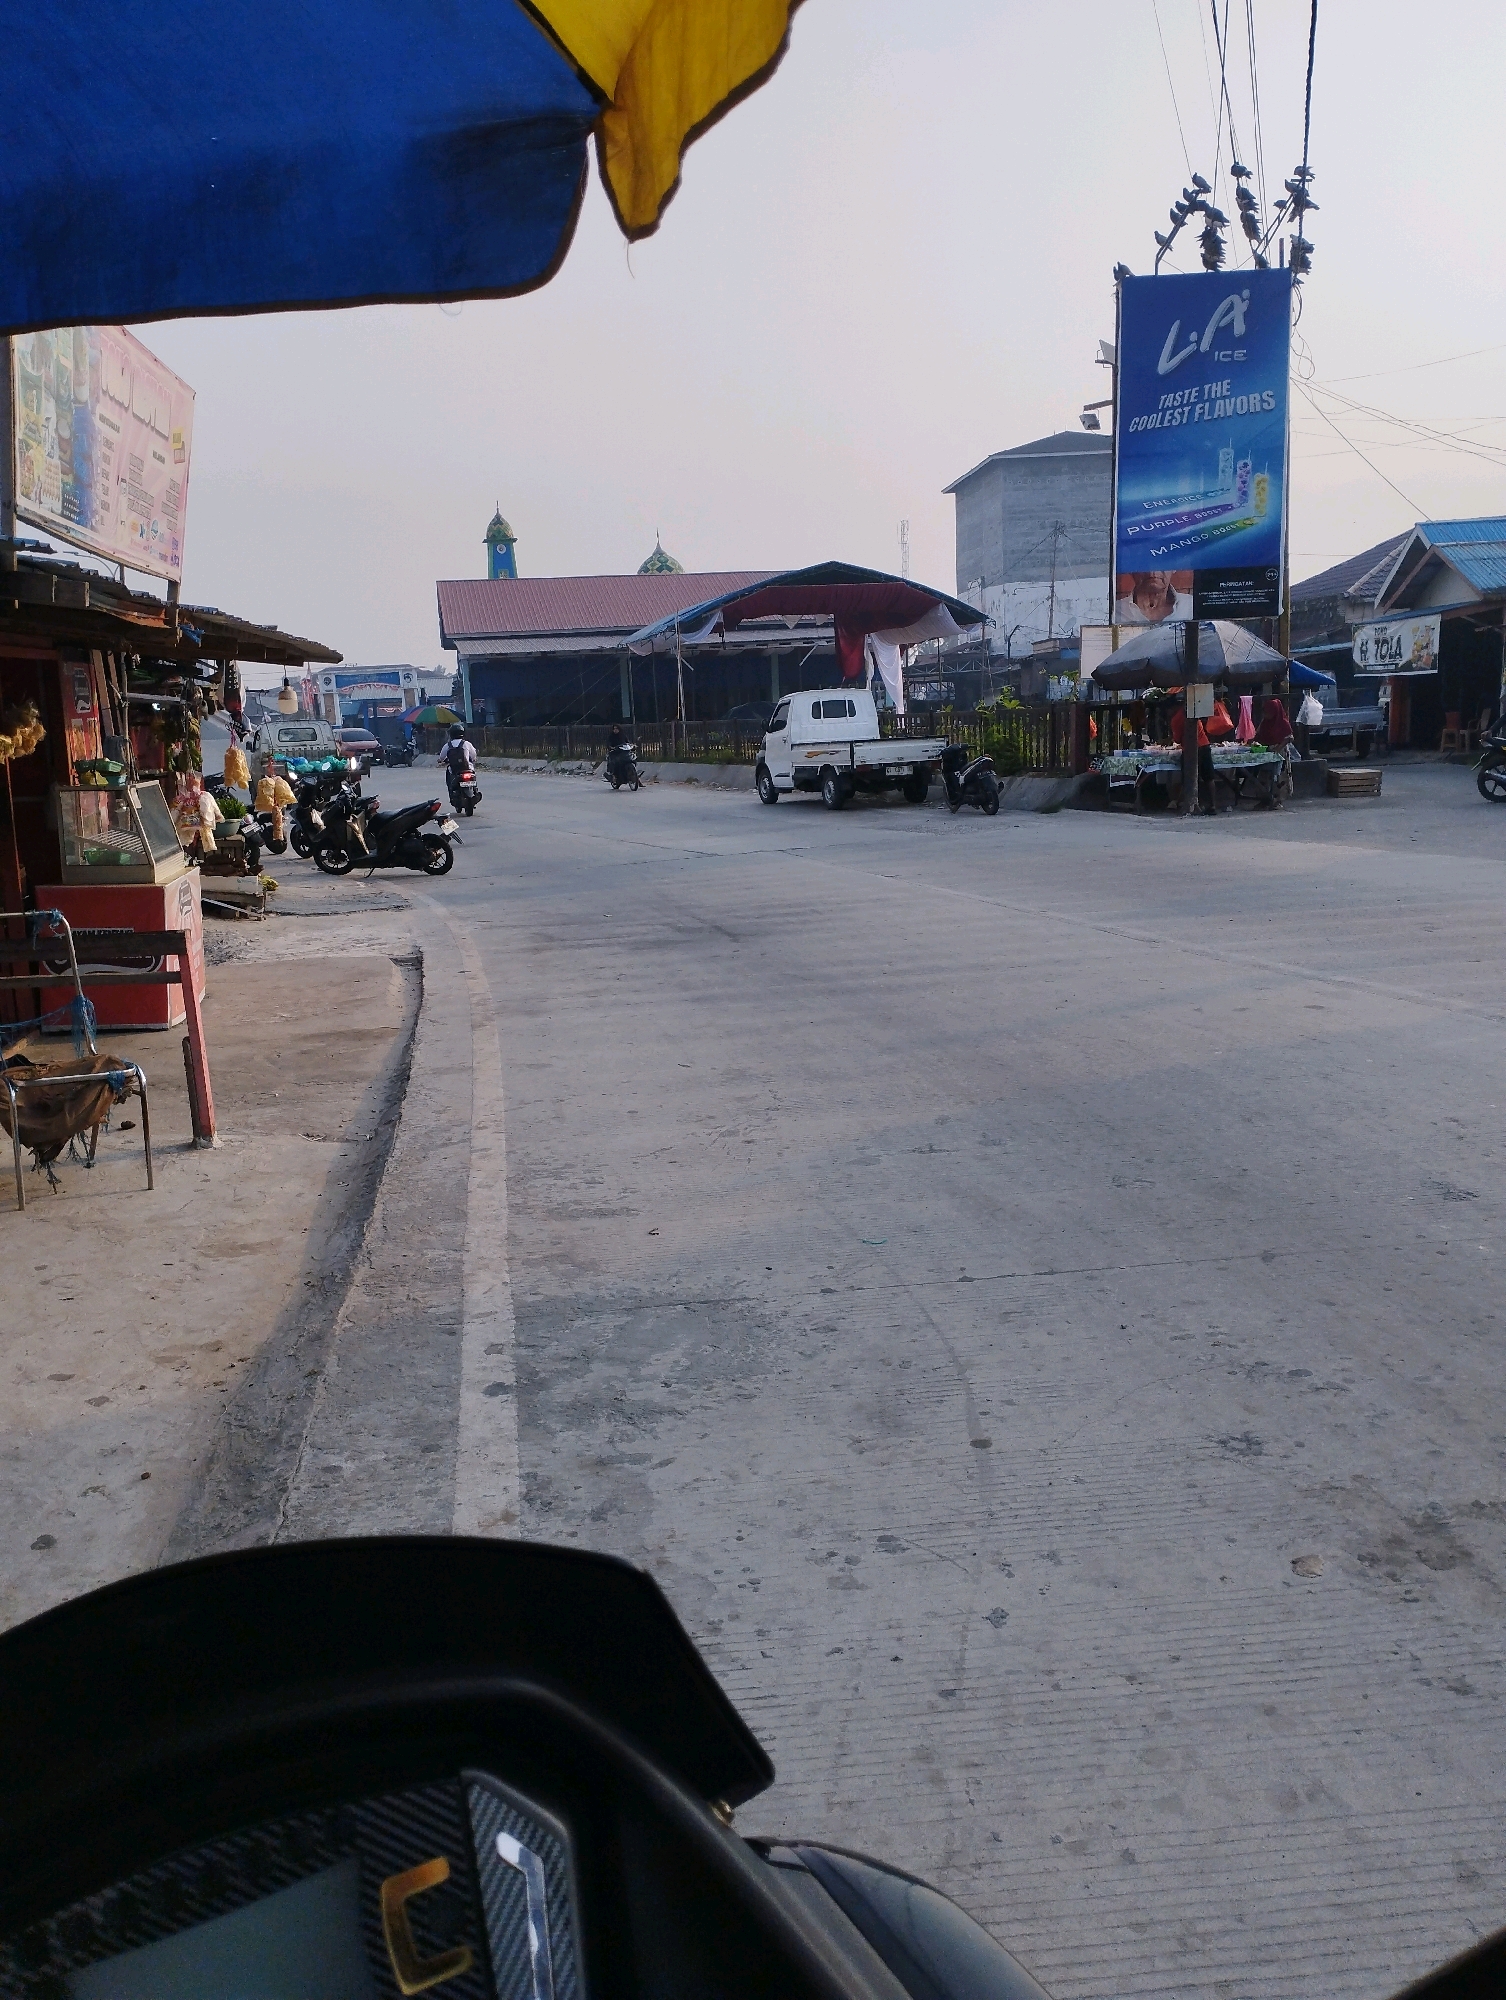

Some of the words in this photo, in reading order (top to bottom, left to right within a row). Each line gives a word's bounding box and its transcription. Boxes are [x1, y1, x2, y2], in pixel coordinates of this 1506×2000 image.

[1214, 350, 1247, 362] ICE
[1158, 386, 1199, 410] TASTE
[1203, 379, 1231, 400] THE
[1128, 405, 1192, 433] COOLEST
[1193, 390, 1276, 422] FLAVORS
[1126, 515, 1192, 536] PURPLE
[1194, 507, 1223, 519] BOOST
[1149, 533, 1209, 557] MANGO
[1211, 522, 1240, 536] BOOST
